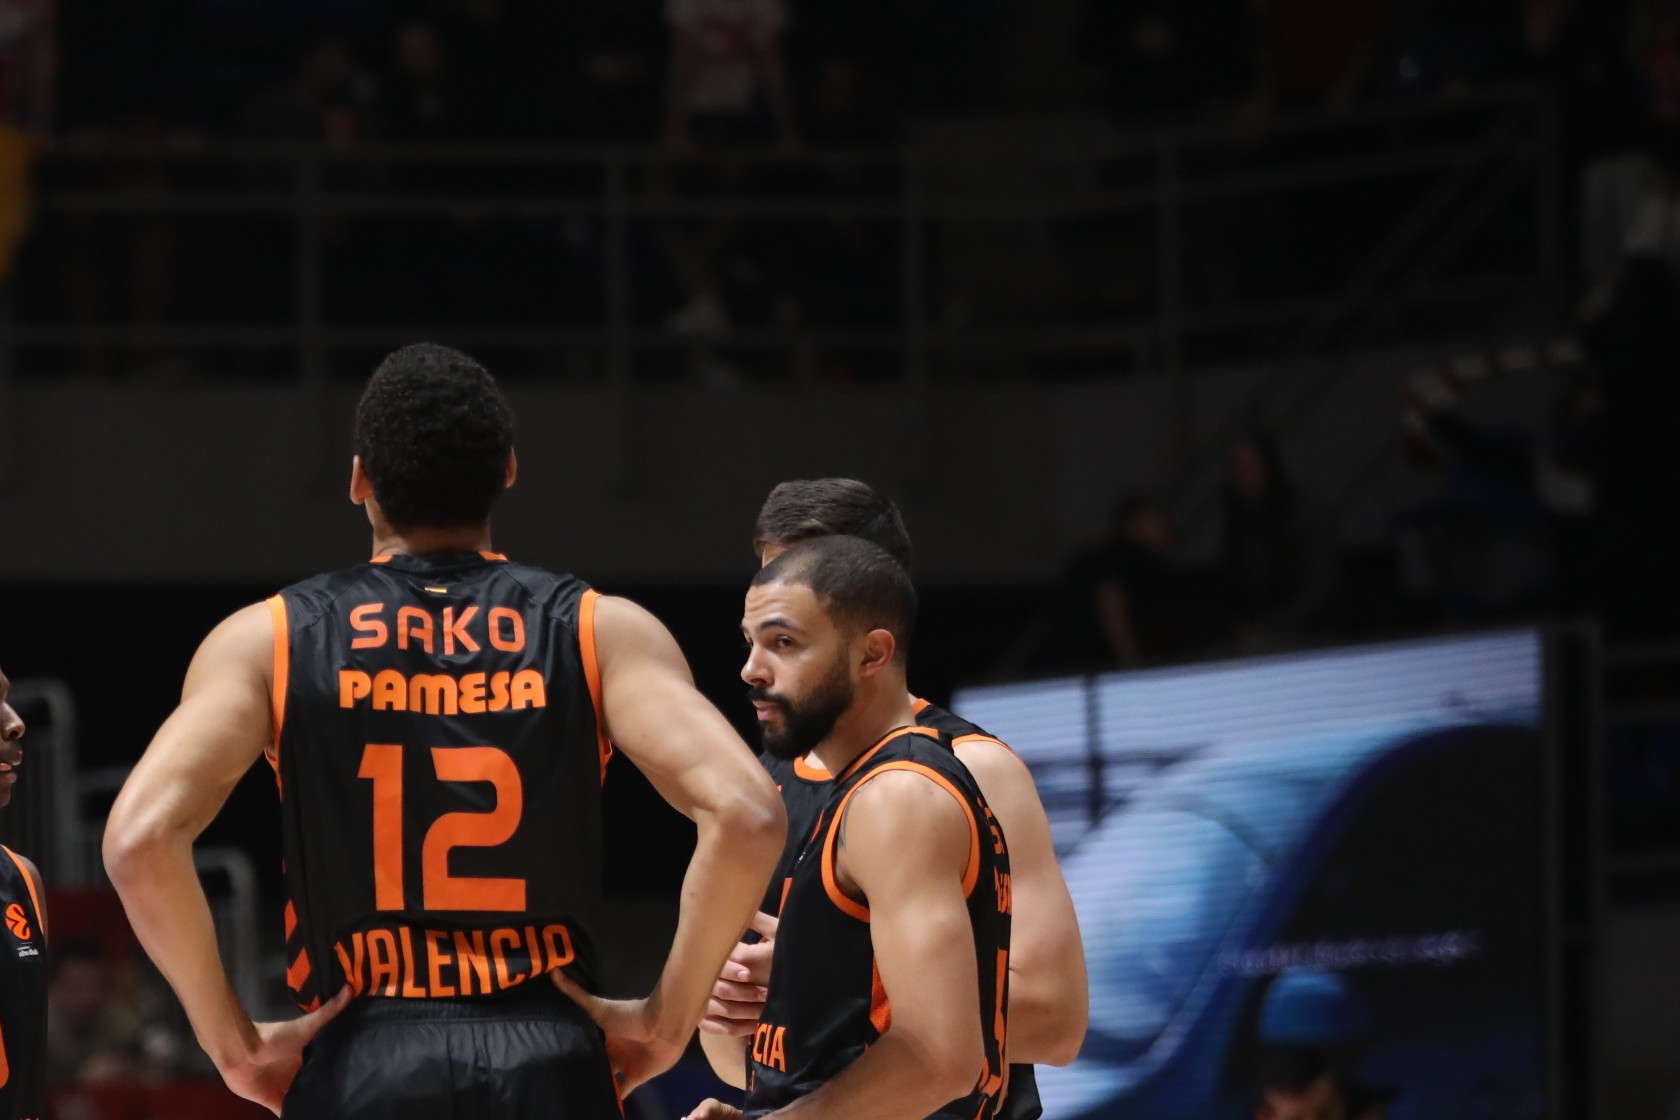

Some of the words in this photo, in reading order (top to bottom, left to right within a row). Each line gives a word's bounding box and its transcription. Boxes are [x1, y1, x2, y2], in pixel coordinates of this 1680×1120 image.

[349, 603, 526, 656] SAKO
[338, 669, 547, 716] PAMESA
[357, 743, 527, 912] 12
[333, 924, 576, 998] VALENCIA
